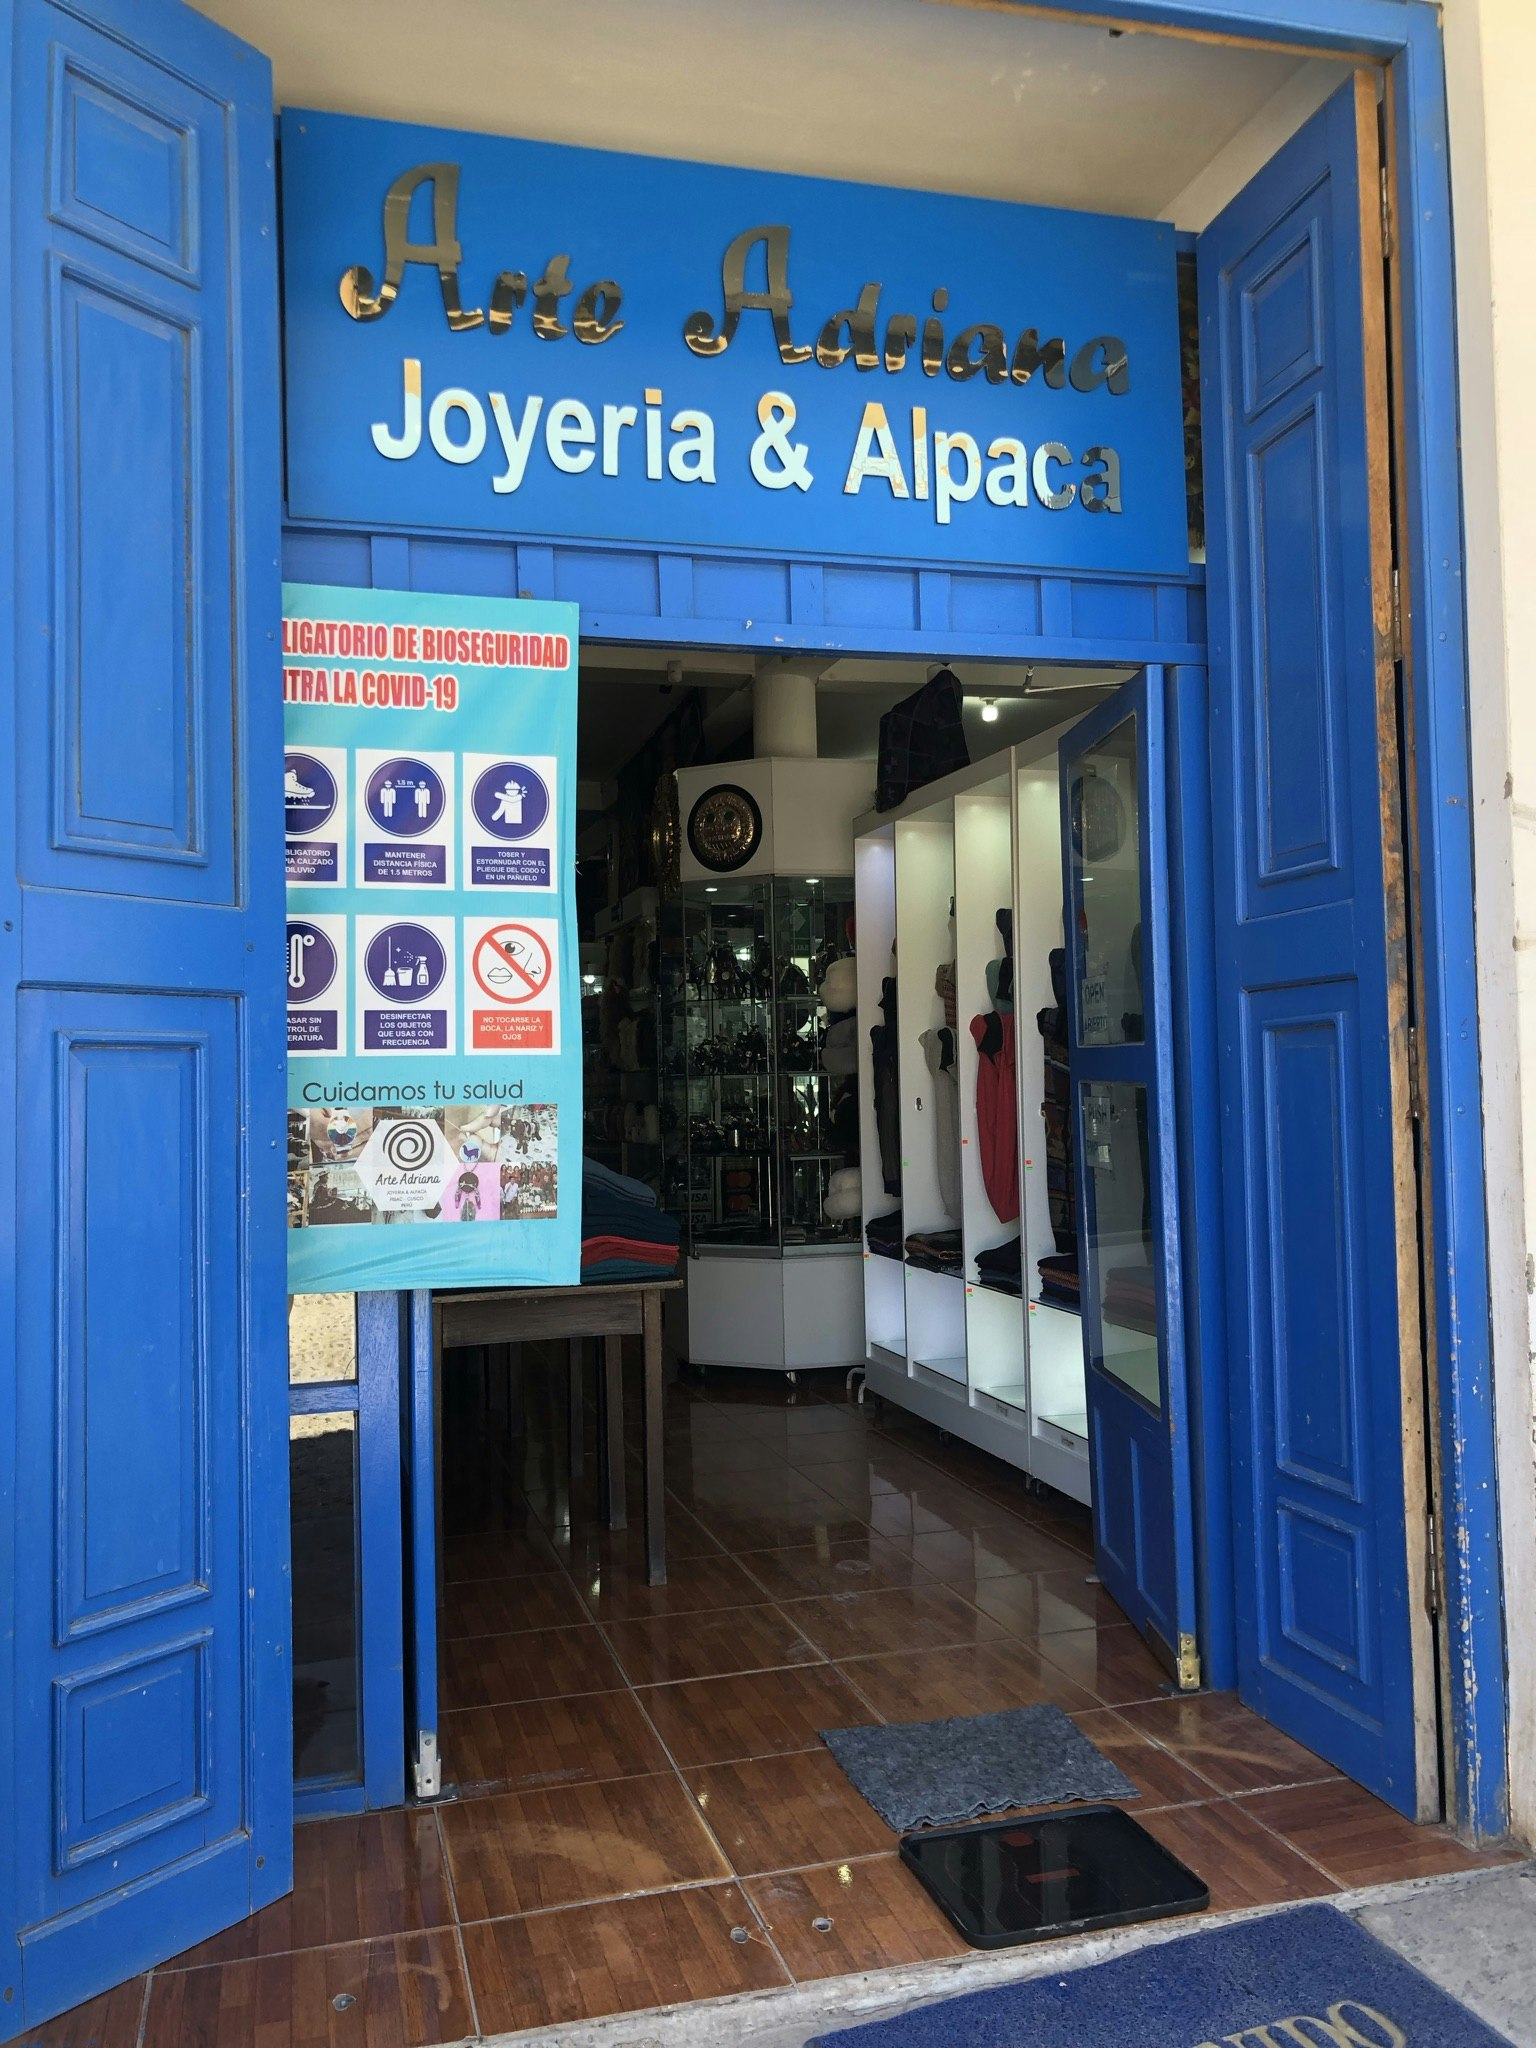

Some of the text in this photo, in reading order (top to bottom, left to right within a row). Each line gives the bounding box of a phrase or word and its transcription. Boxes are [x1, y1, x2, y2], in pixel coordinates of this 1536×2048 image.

[339, 162, 1129, 395] Arte Adriana
[371, 358, 1122, 524] Joyeria & Alpaca
[392, 626, 418, 660] DE
[422, 628, 568, 669] BIOSEGURIDAD
[333, 671, 358, 705] LA
[362, 672, 457, 710] COVID-19
[384, 851, 426, 859] MANTENER
[297, 858, 334, 866] CALZADO
[373, 860, 438, 868] DISTANCIA FÍSICA
[378, 868, 389, 876] DE
[402, 869, 433, 877] METROS
[507, 874, 538, 882] PAÑUELO
[380, 1021, 432, 1029] LOS OBJETOS
[502, 1033, 522, 1041] OJOS
[302, 1079, 523, 1103] Cuidamos tu salud
[375, 1172, 441, 1186] Arte Adriana
